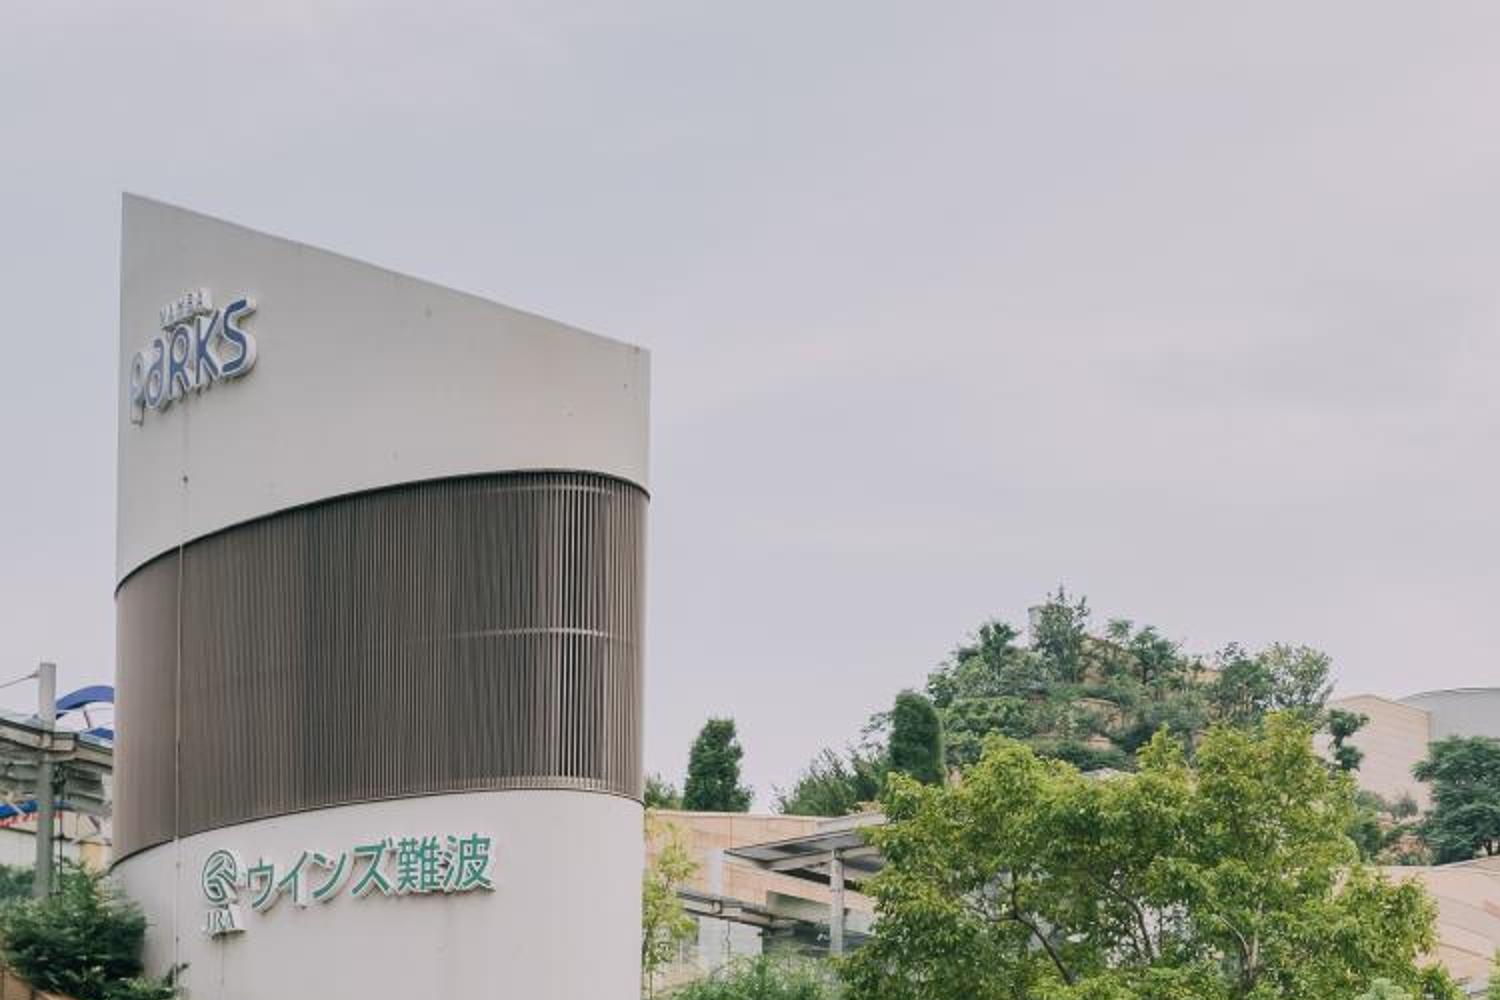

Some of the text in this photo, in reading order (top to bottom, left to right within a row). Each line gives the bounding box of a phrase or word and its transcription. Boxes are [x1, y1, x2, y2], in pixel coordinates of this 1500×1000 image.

[246, 832, 493, 911] ウインズ難波
